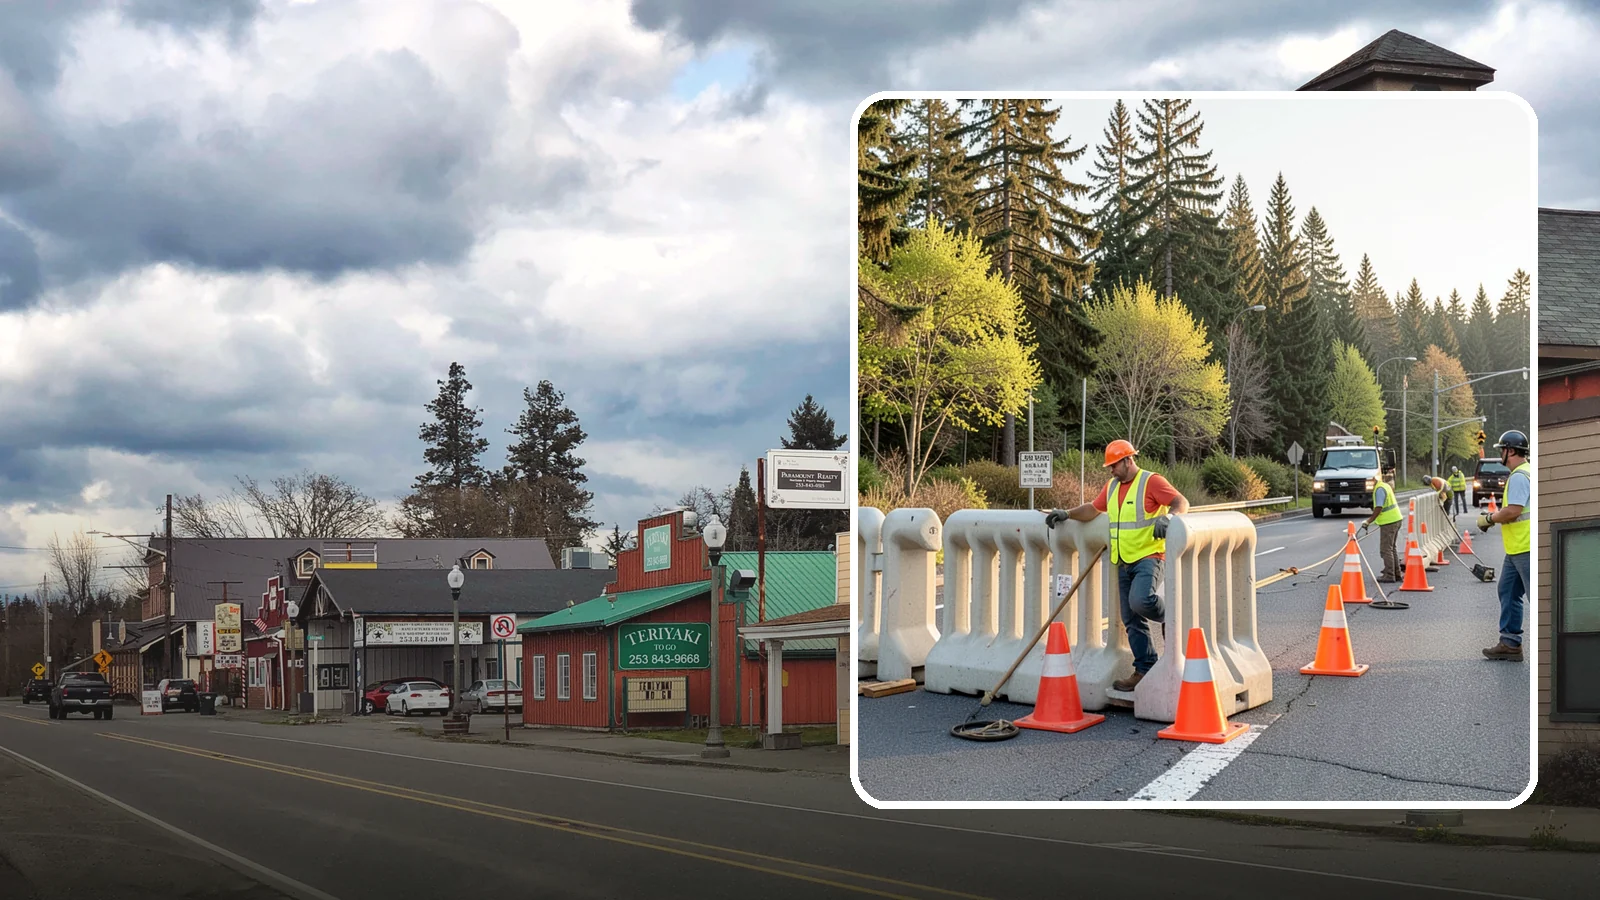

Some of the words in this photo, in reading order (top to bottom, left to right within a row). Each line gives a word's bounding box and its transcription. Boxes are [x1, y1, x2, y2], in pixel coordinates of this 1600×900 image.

[625, 627, 702, 646] TERIYAKI
[629, 654, 648, 665] 253
[651, 653, 700, 664] 843-9668
[639, 681, 672, 691] TERIYAKI
